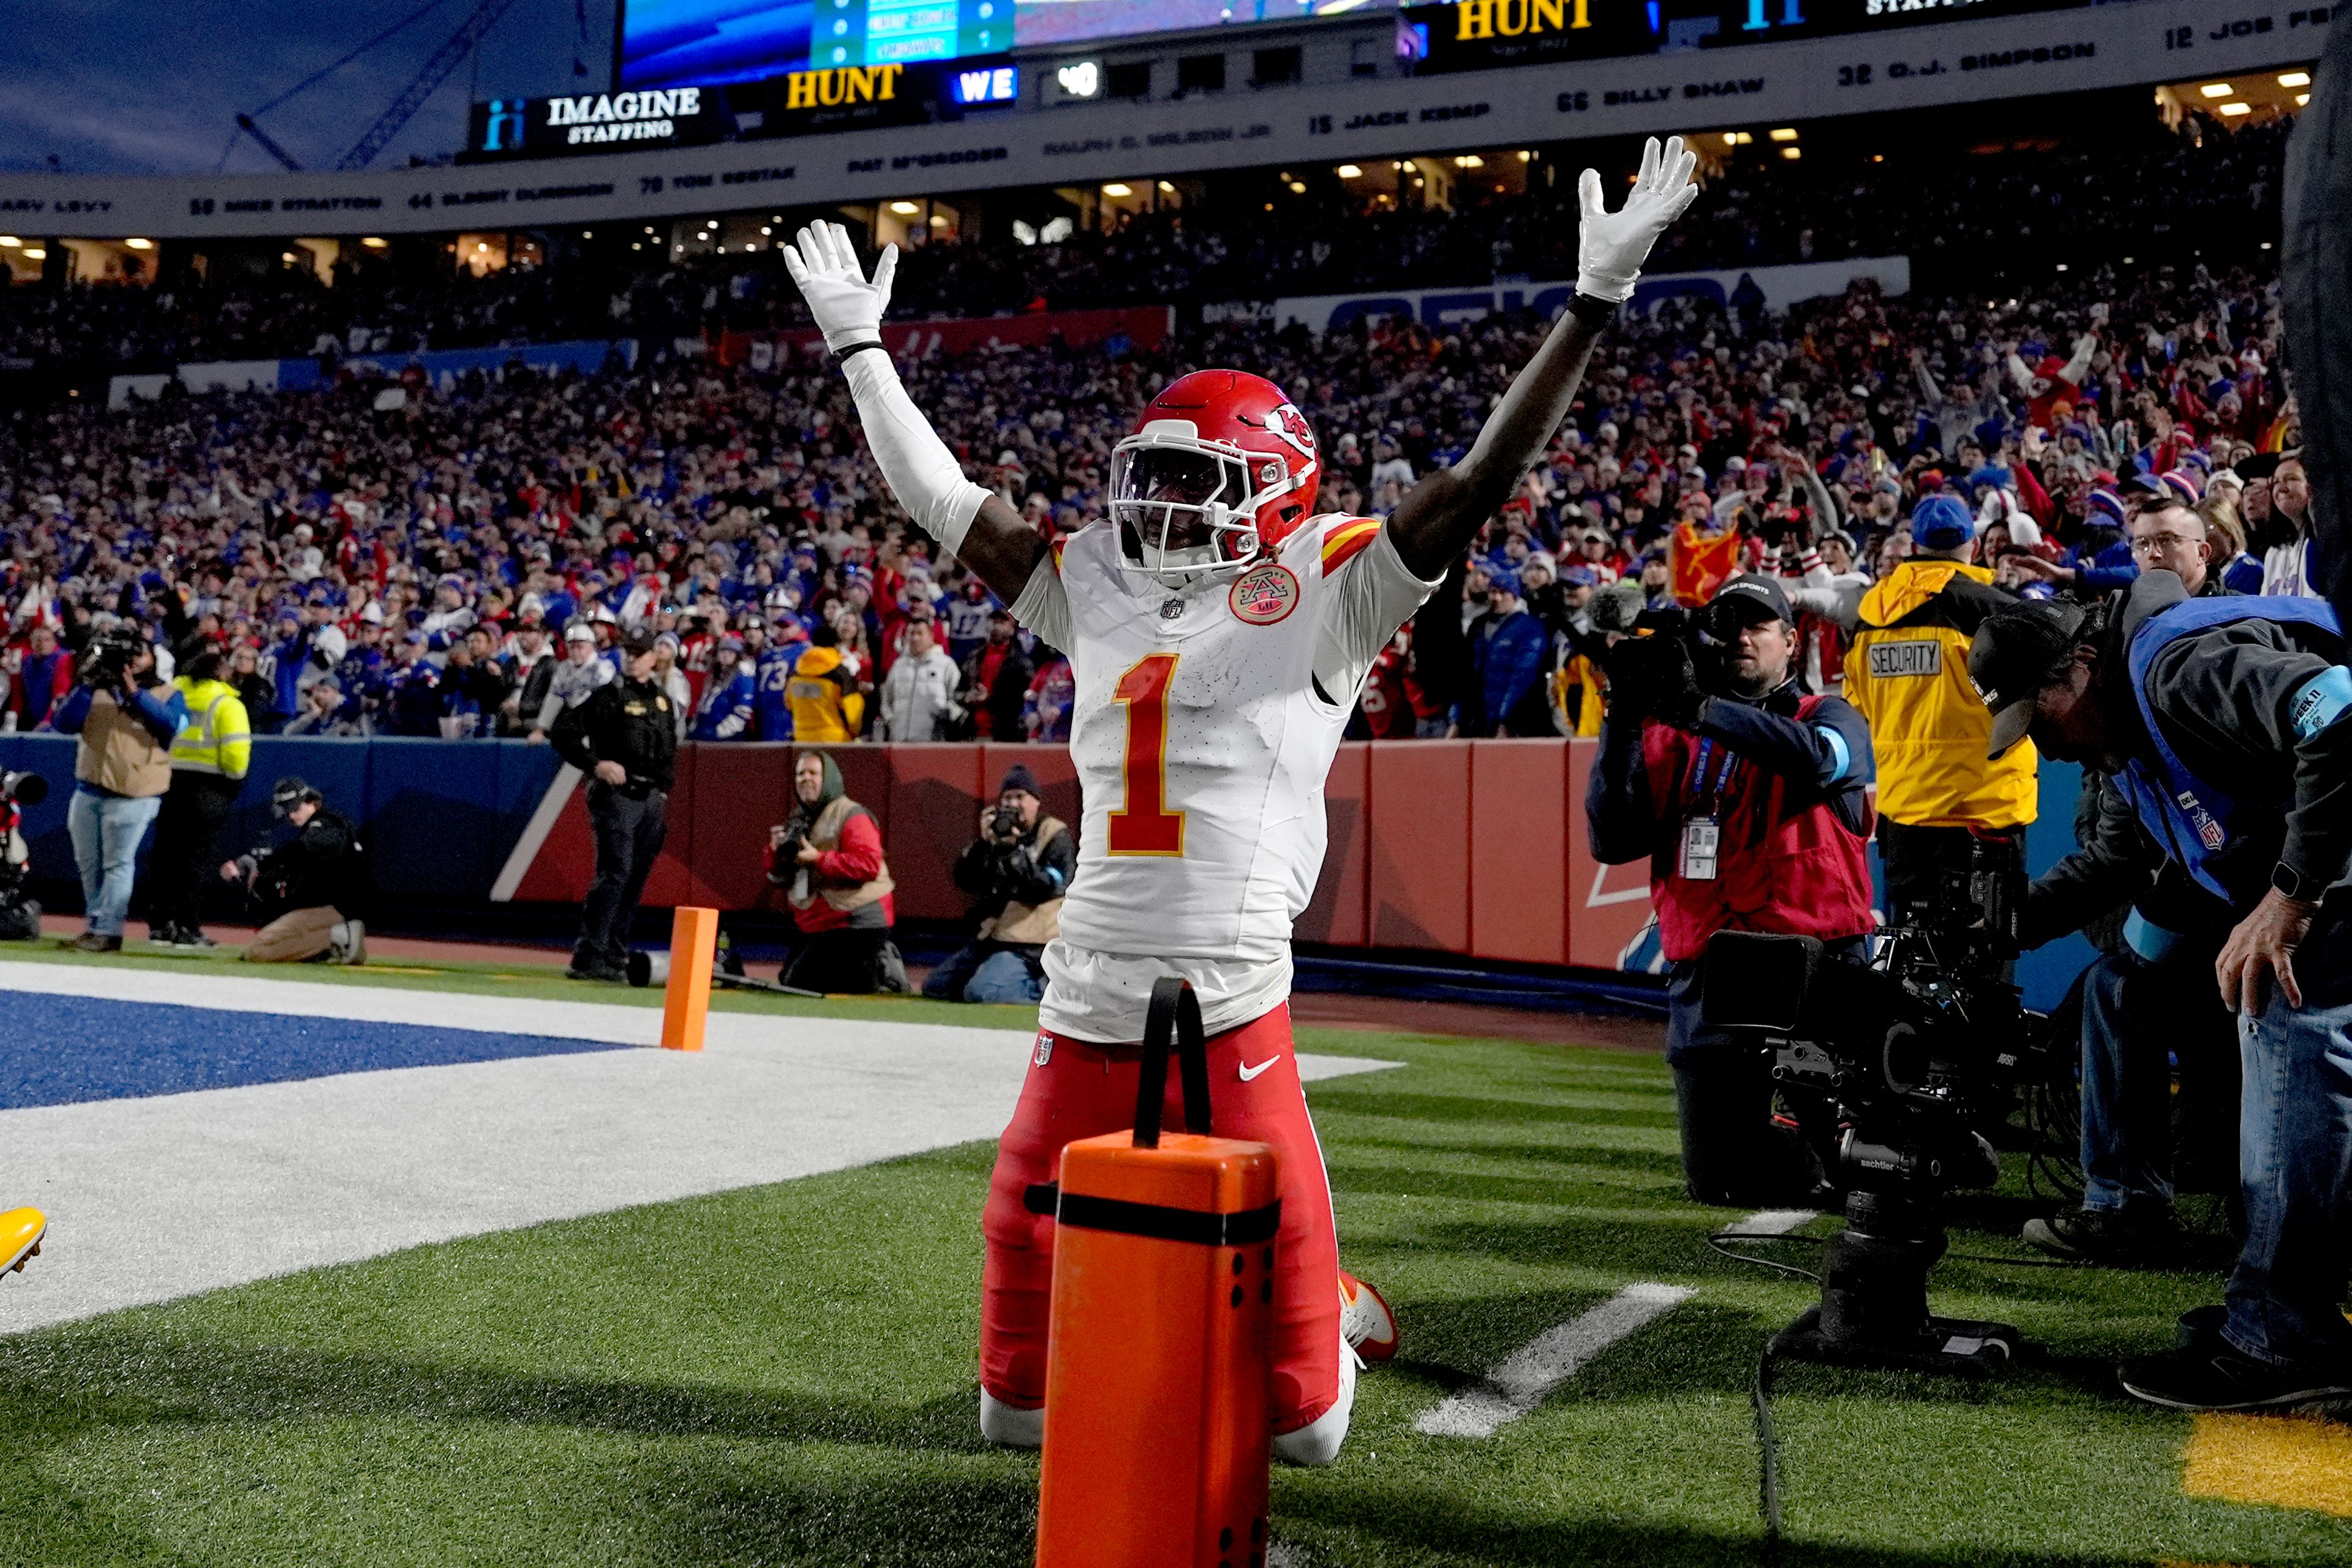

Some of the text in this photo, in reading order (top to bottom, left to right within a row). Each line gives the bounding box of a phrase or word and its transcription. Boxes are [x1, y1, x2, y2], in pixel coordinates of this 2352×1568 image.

[1456, 0, 1593, 40] HUNT
[786, 64, 903, 109] HUNT
[960, 69, 1012, 102] WE
[546, 87, 700, 126] IMAGINE
[567, 119, 674, 144] STAFFING
[1872, 644, 1937, 673] SECURITY
[2293, 696, 2314, 726] WEEK
[2309, 689, 2321, 699] 11
[1107, 653, 1186, 858] 1
[2201, 822, 2222, 845] NFL
[1861, 1159, 1894, 1170] sachtler
